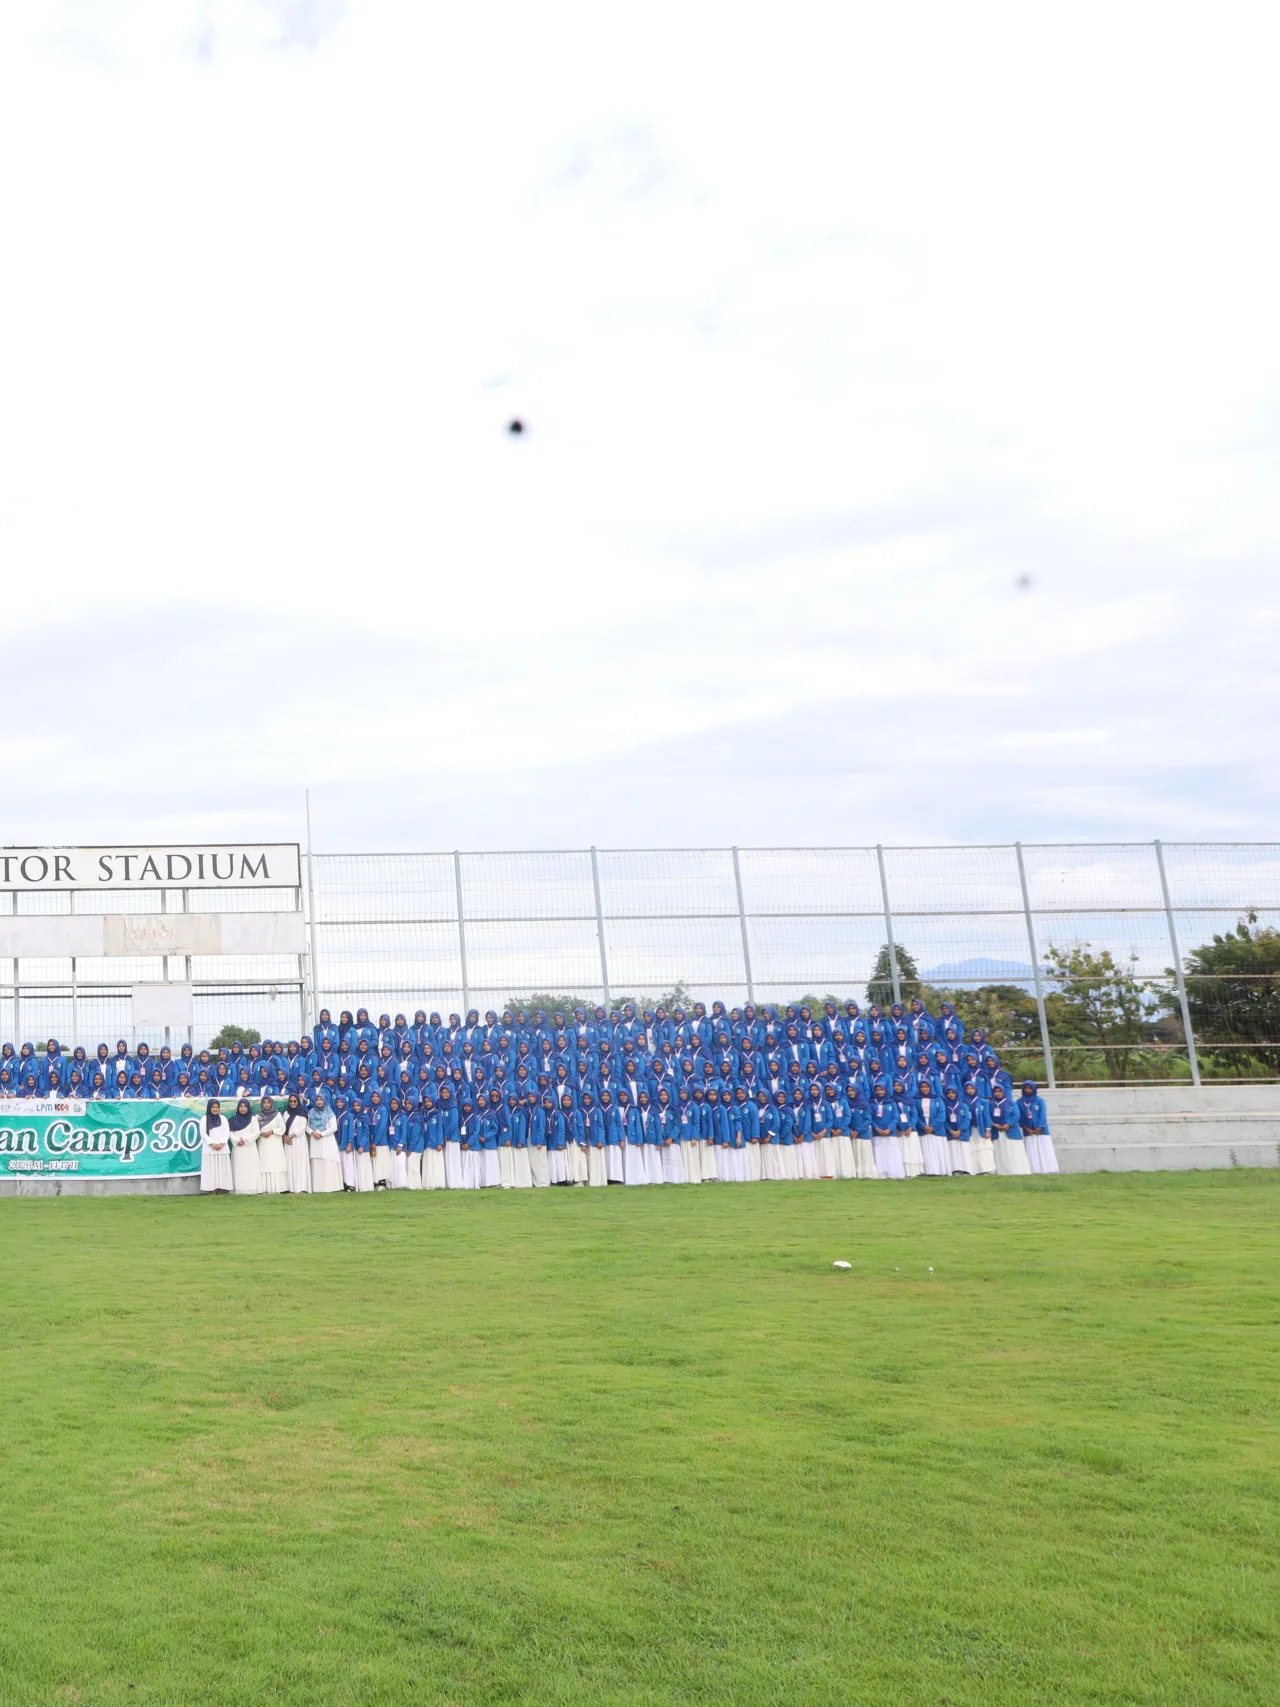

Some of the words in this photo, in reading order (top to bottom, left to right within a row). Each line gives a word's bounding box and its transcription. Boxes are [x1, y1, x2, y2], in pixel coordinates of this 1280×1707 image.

[96, 852, 271, 882] STADIUM
[36, 1103, 53, 1112] LPM
[45, 1120, 146, 1161] Camp
[151, 1119, 202, 1151] 3.0
